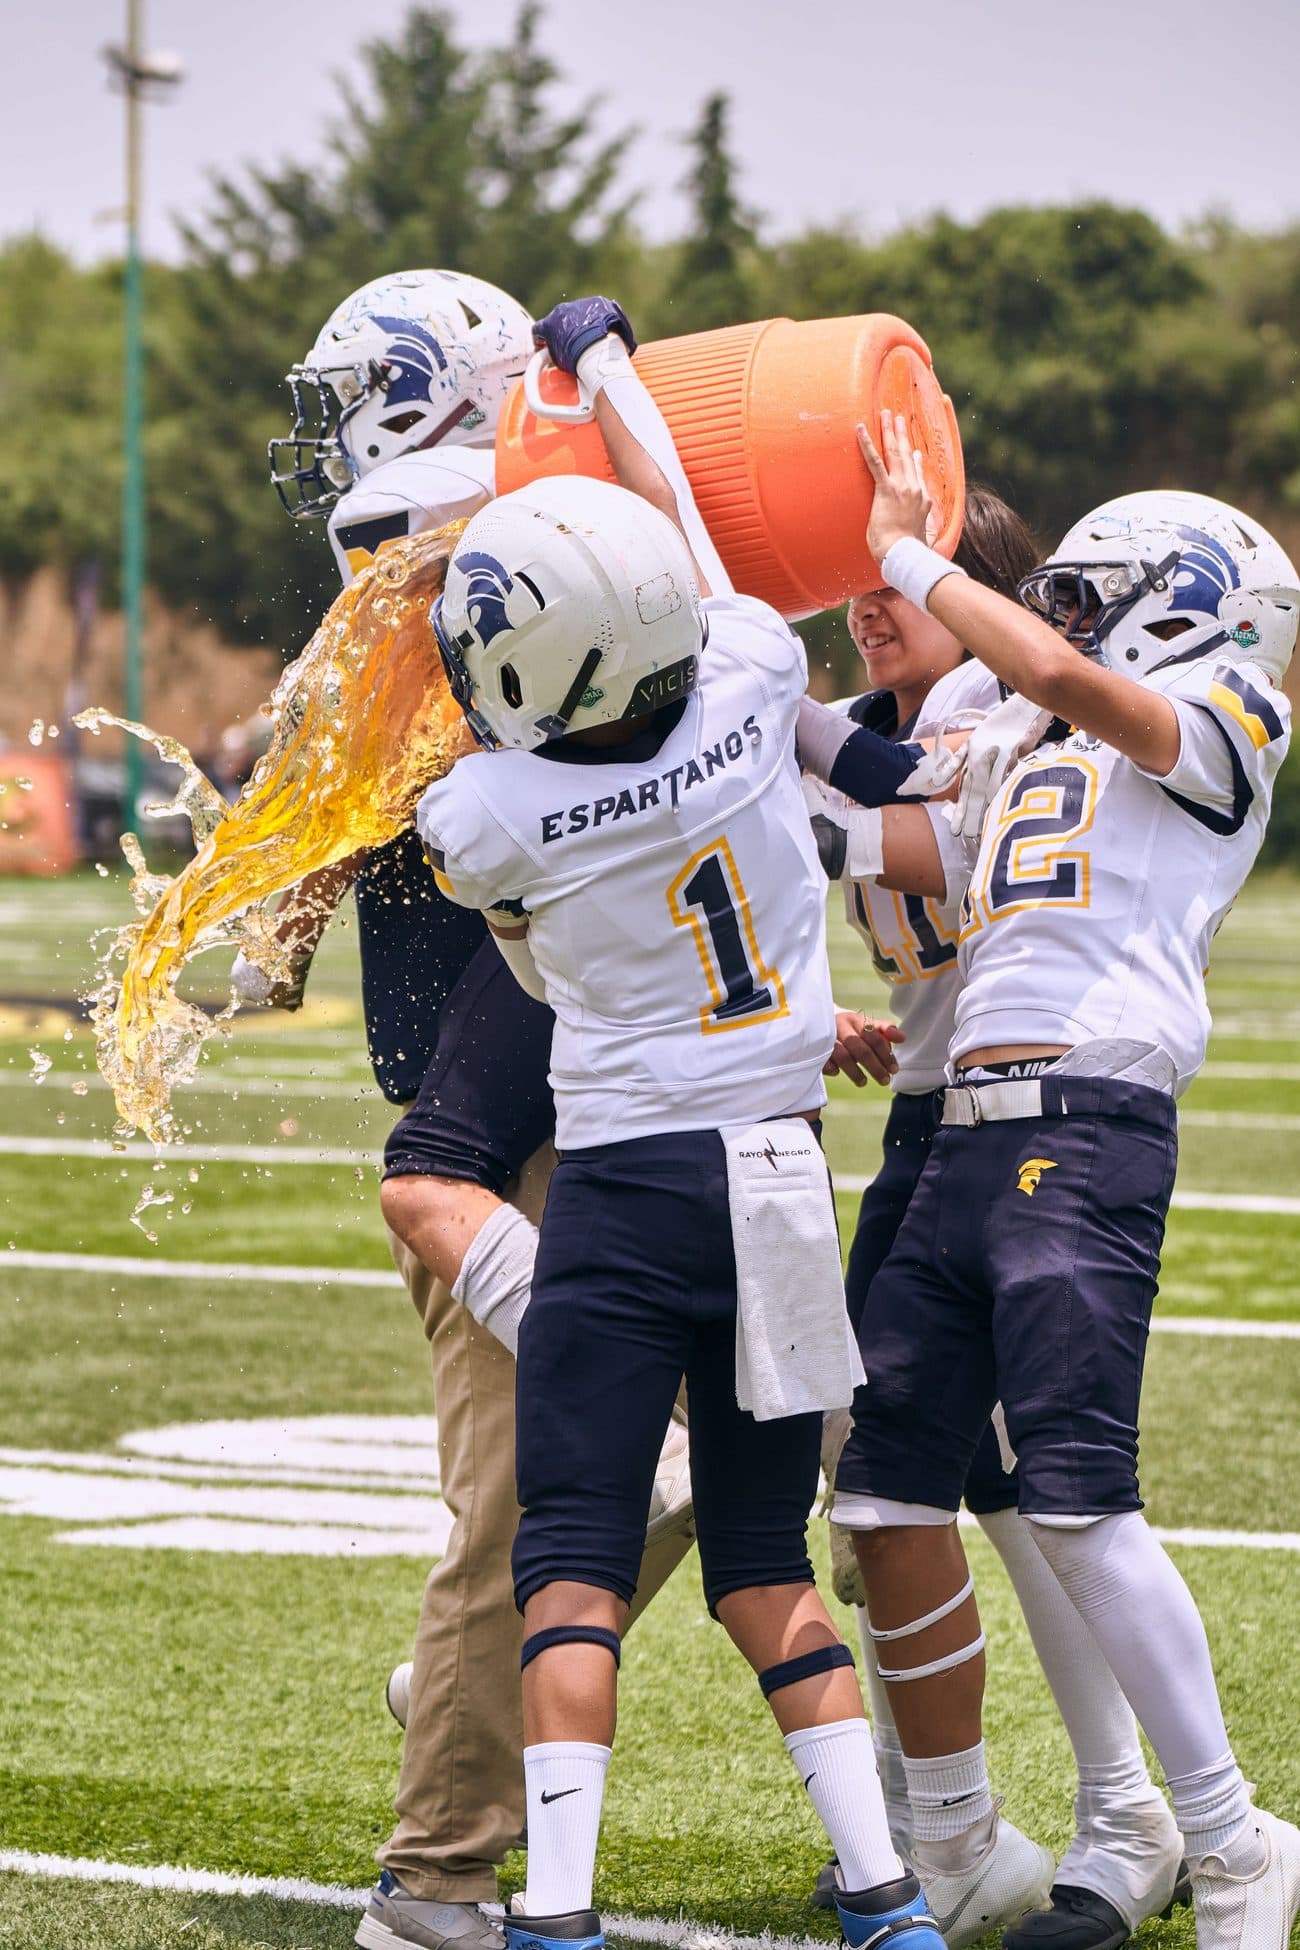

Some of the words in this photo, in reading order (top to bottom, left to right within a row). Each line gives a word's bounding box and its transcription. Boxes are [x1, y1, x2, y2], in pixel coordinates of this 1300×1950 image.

[640, 665, 695, 701] VICIS
[540, 715, 763, 844] ESPARTANOS
[668, 836, 788, 1033] 1
[738, 1151, 764, 1159] RAYO
[778, 1149, 812, 1158] NEGRO
